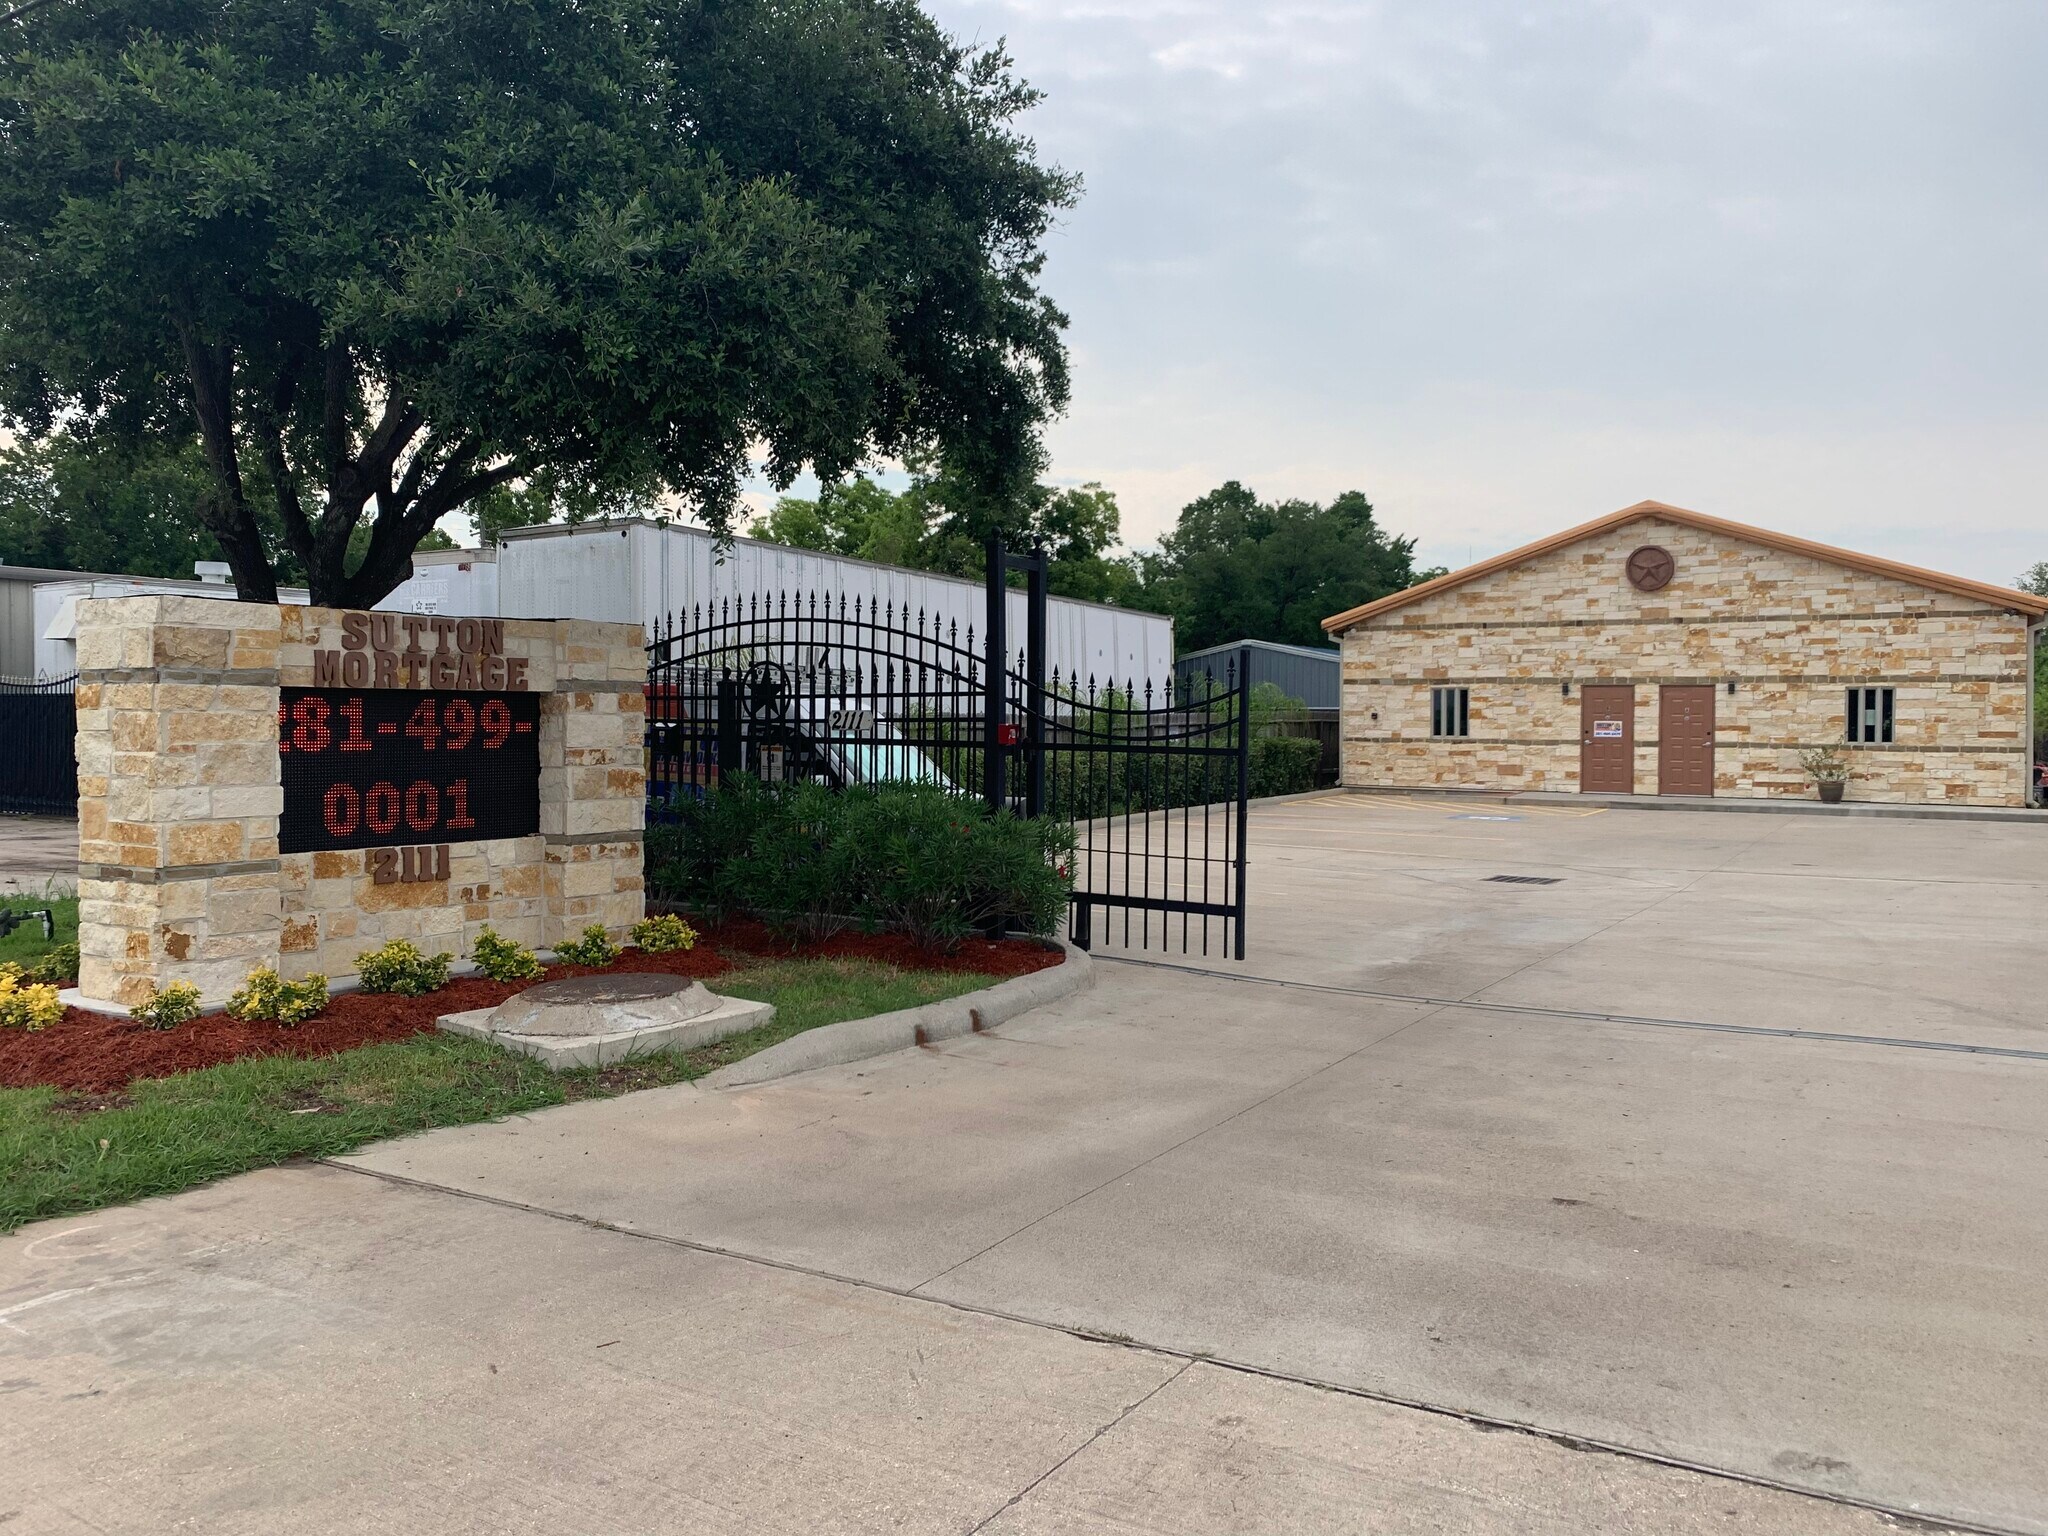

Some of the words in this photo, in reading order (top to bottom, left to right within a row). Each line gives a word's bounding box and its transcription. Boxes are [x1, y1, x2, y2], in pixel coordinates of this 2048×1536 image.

[341, 613, 505, 655] SUTTON
[313, 649, 529, 691] MORTGAGE
[832, 711, 864, 730] 2111
[323, 779, 475, 837] 0001
[373, 845, 451, 884] 2111
